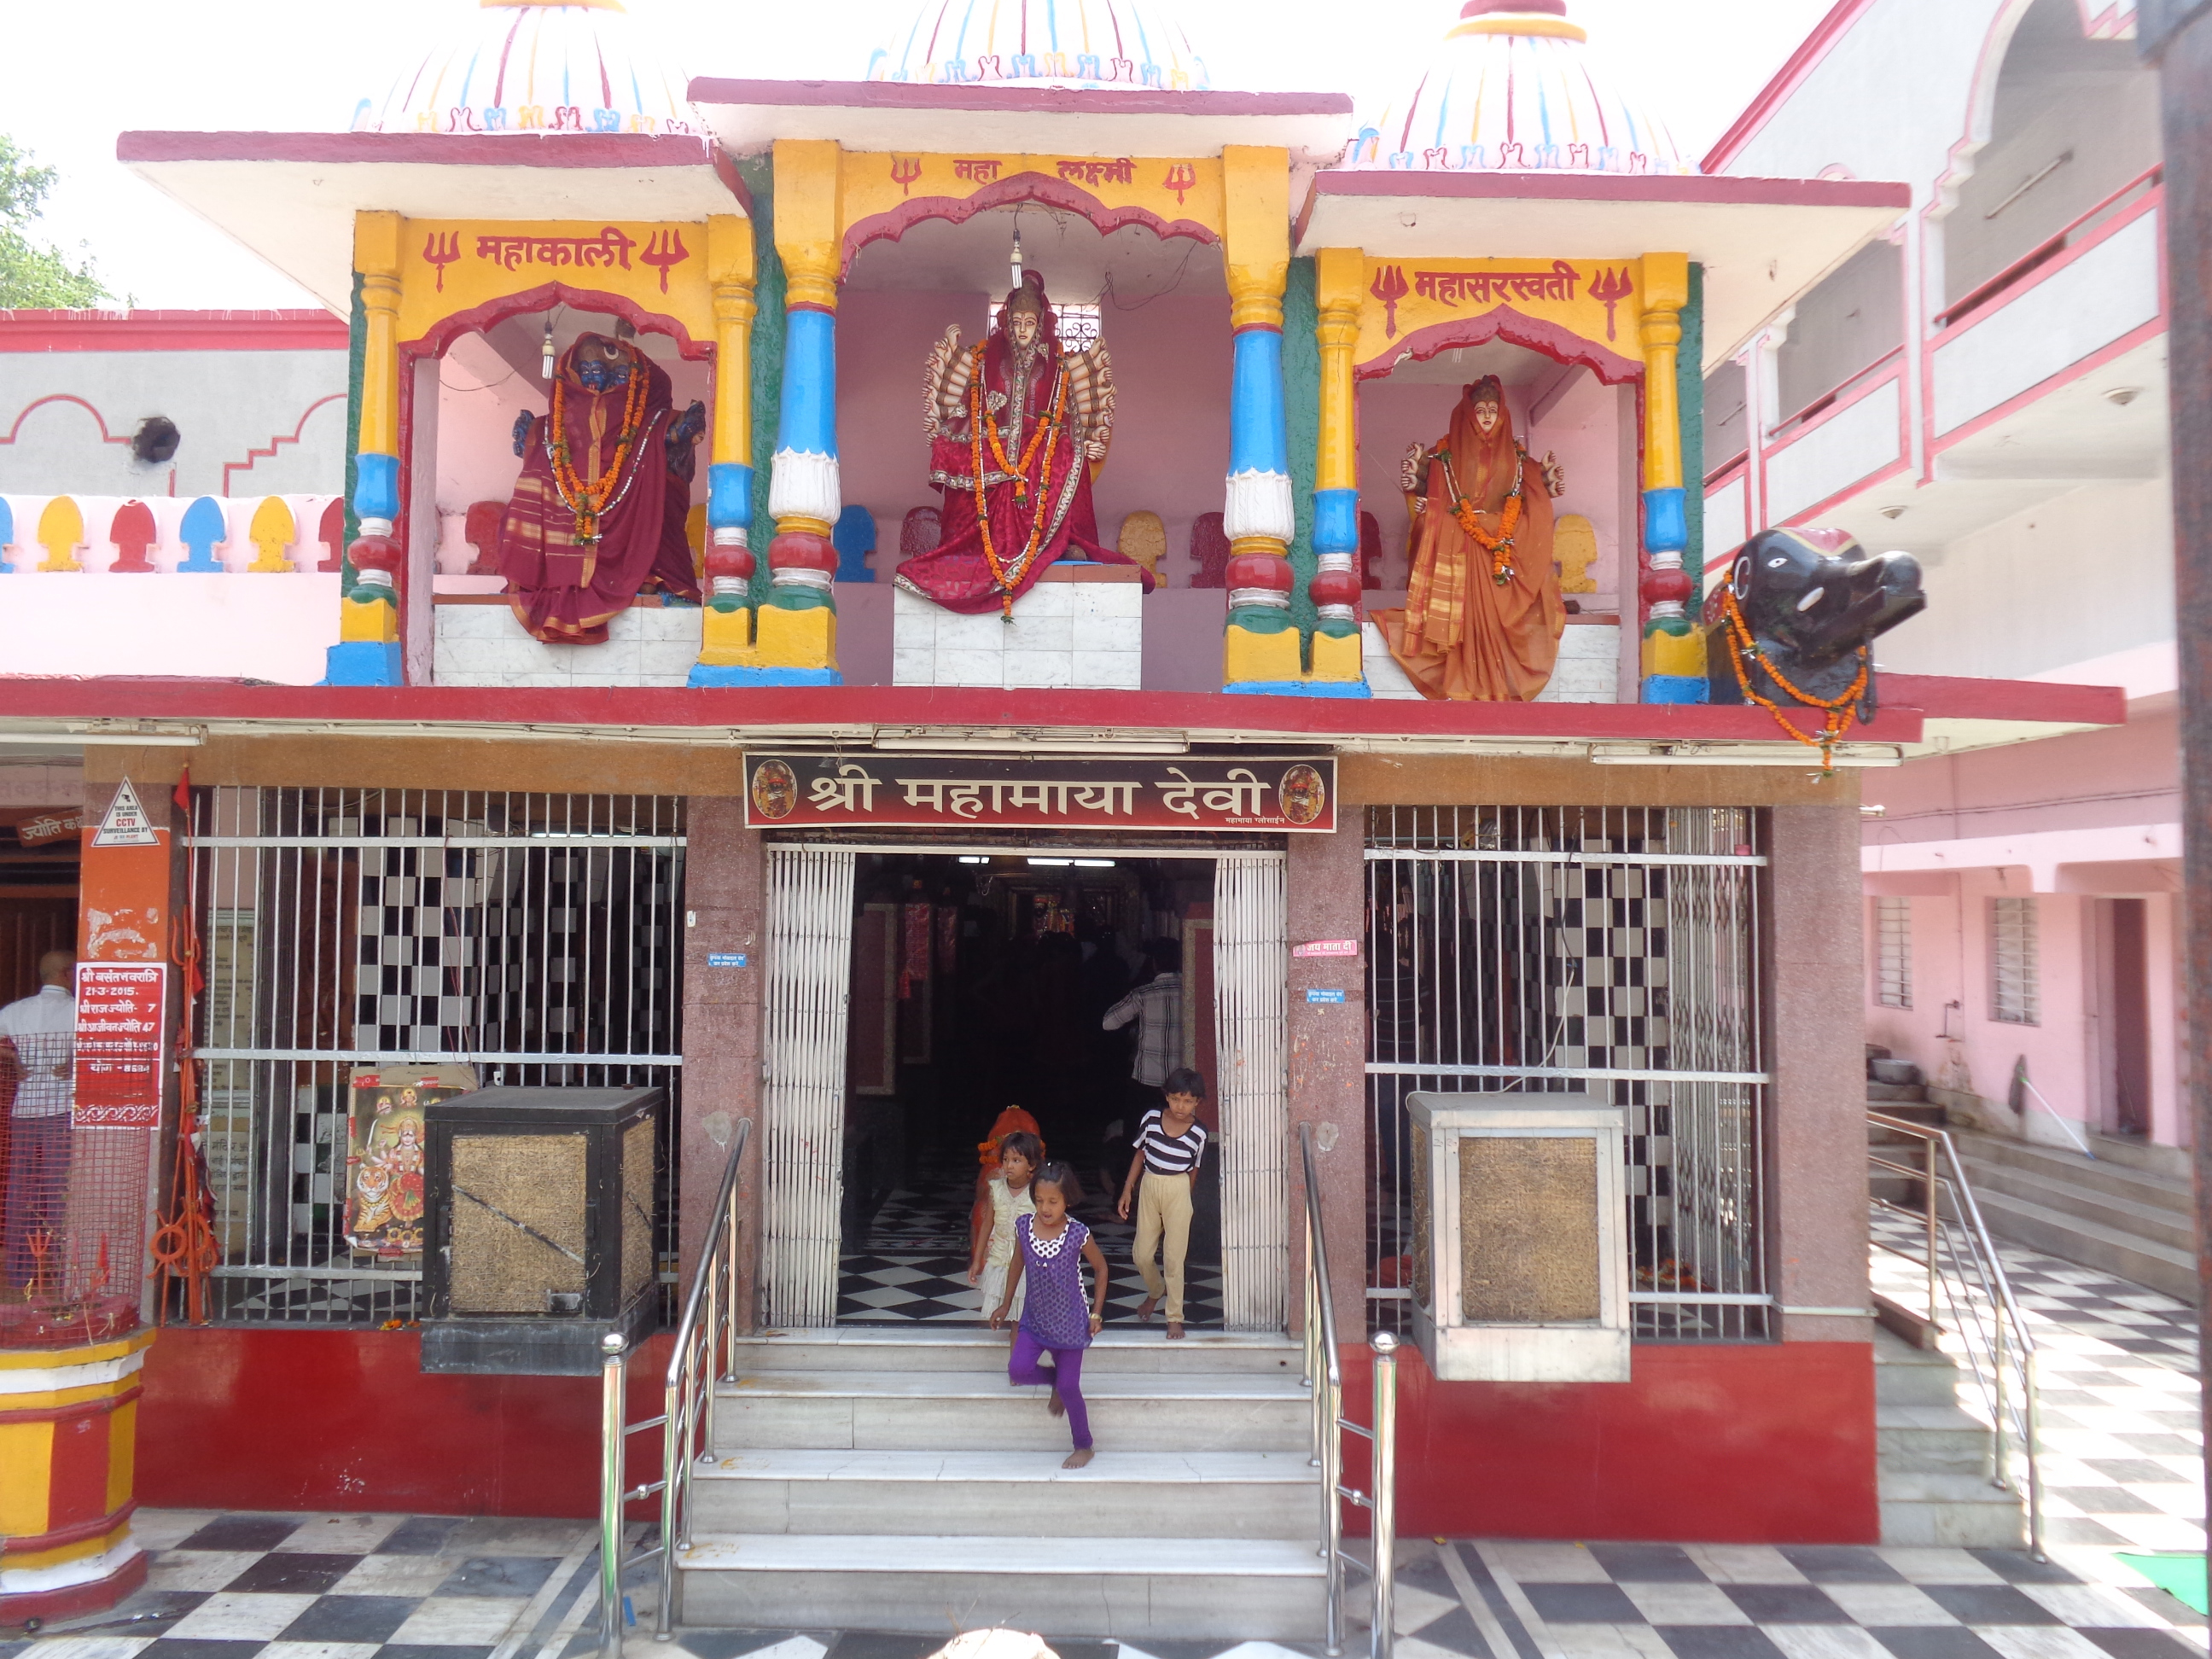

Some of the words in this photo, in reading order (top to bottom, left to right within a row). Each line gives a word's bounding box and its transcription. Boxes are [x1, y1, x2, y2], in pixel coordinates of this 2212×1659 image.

[953, 160, 1003, 184] महा
[1057, 157, 1138, 187] लक्ष्मी
[476, 226, 637, 271] महाकाली
[1414, 259, 1581, 307] महासरस्वती
[807, 764, 882, 812] श्री
[894, 777, 1144, 819] महामाया
[1154, 766, 1272, 819] देवी
[21, 818, 61, 841] ज्योति
[116, 818, 136, 827] CCTV
[1323, 942, 1341, 951] माता
[1342, 940, 1352, 951] दी
[148, 1004, 156, 1013] 7
[143, 1022, 155, 1032] 47
